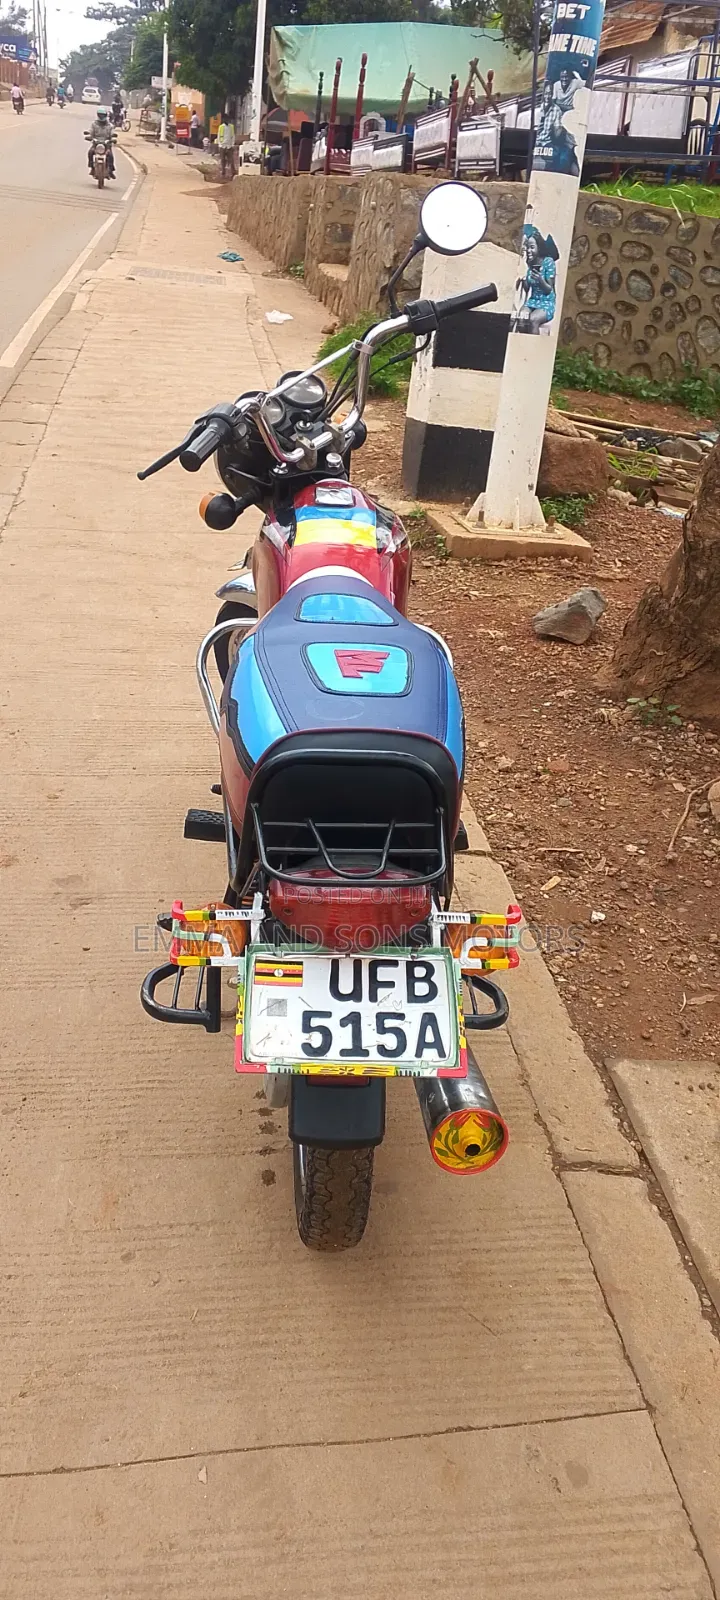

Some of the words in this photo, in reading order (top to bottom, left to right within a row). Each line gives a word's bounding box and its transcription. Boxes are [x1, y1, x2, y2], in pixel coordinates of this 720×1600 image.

[556, 2, 591, 20] BET
[569, 34, 597, 57] TIME
[329, 959, 439, 1004] UFB
[300, 1010, 447, 1059] 515A
